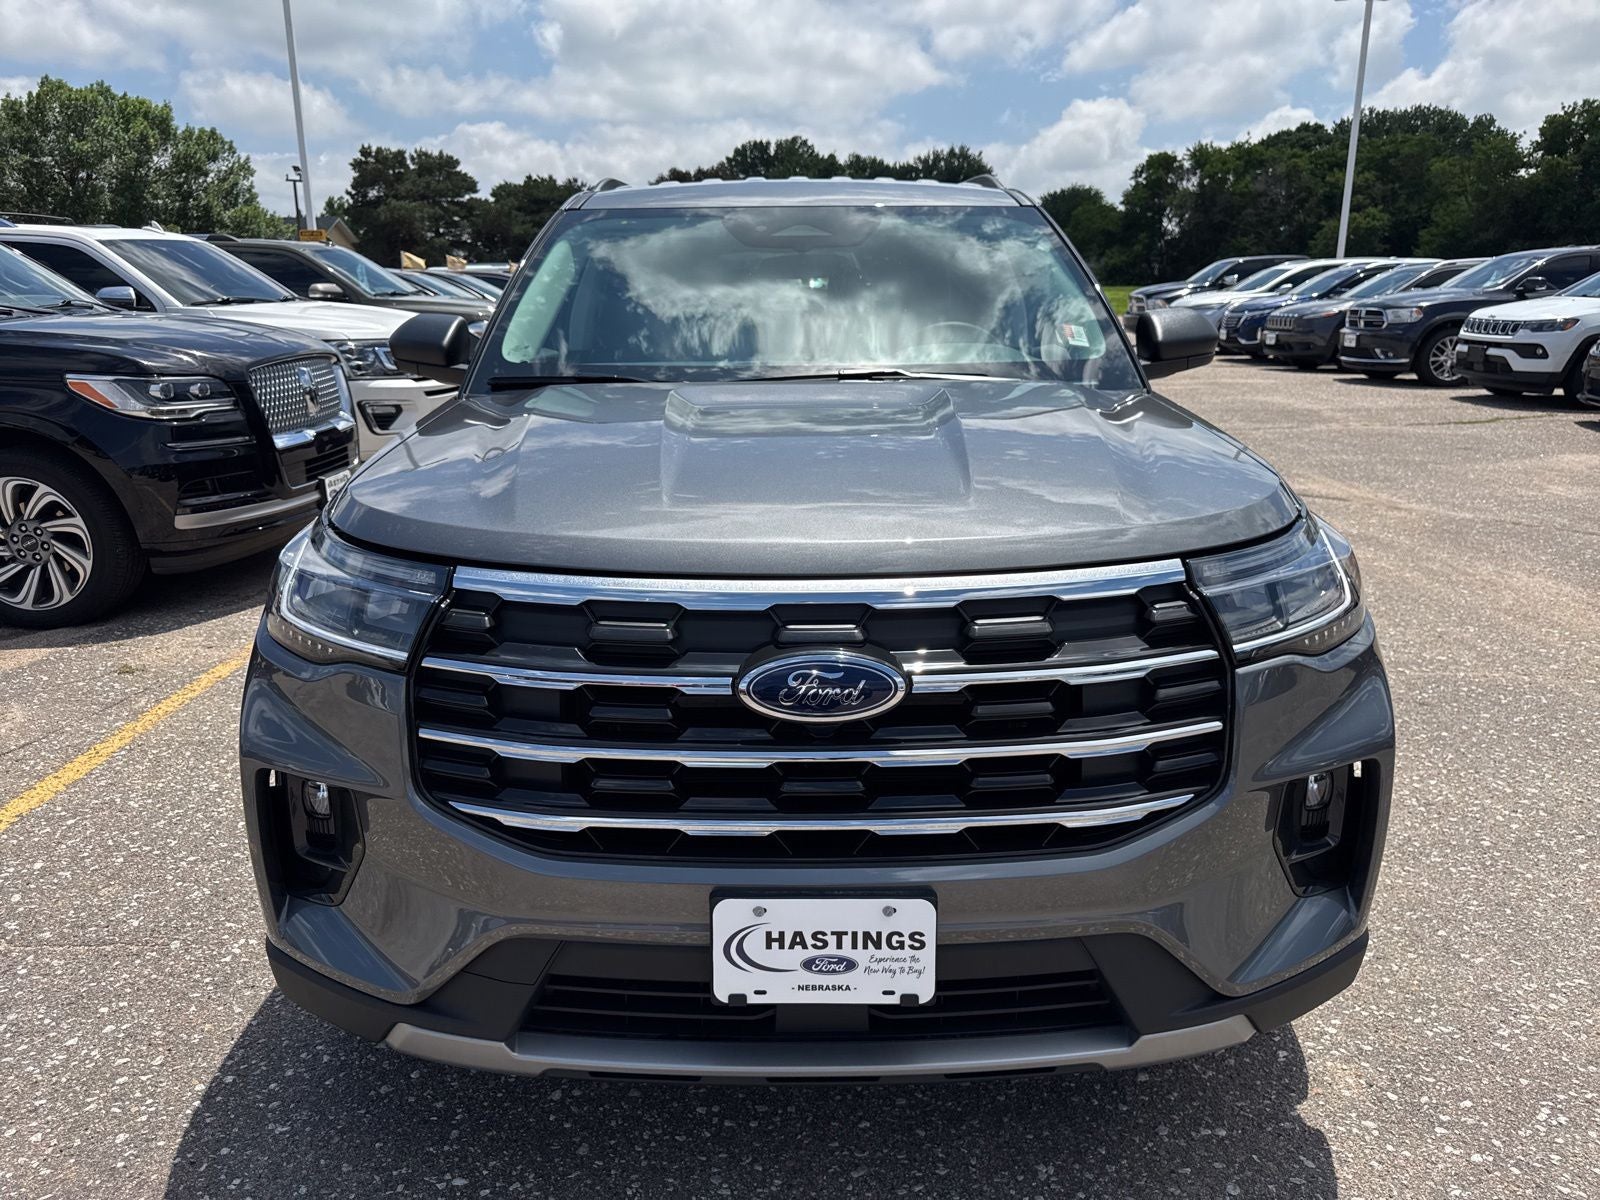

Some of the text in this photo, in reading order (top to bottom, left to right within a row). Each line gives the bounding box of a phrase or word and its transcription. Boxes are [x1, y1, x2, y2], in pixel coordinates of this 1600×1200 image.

[778, 669, 867, 706] Ford
[765, 930, 927, 951] HASTINGS
[812, 957, 847, 971] Ford
[868, 954, 908, 966] Experience
[863, 965, 880, 976] New
[880, 964, 897, 979] Way
[906, 965, 926, 980] Buy!
[797, 984, 852, 992] NEBRASKA
